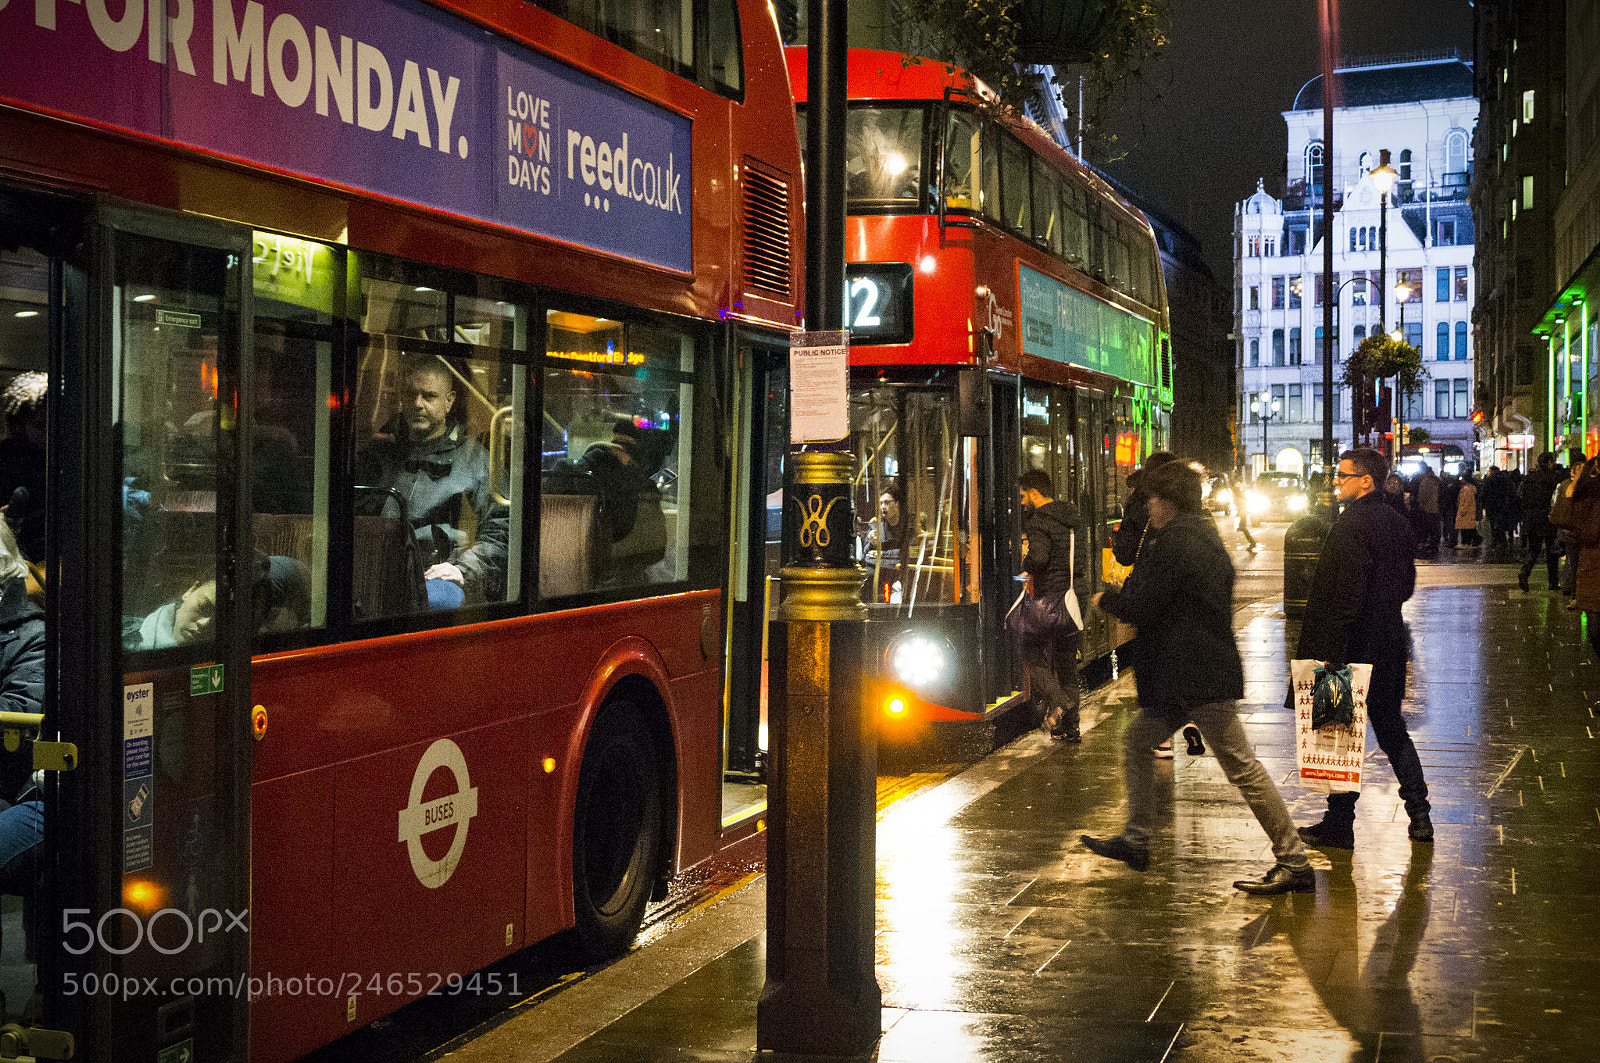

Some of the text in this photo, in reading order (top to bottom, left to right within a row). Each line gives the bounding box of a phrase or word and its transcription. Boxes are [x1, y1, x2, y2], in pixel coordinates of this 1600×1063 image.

[213, 0, 469, 159] MONDAY.
[507, 85, 550, 129] LOVE
[508, 154, 550, 196] DAYS
[567, 128, 682, 215] reed.co.uk
[614, 351, 645, 365] Brdge
[793, 348, 846, 357] PUBLIC NOTICE
[425, 801, 454, 826] BUSES
